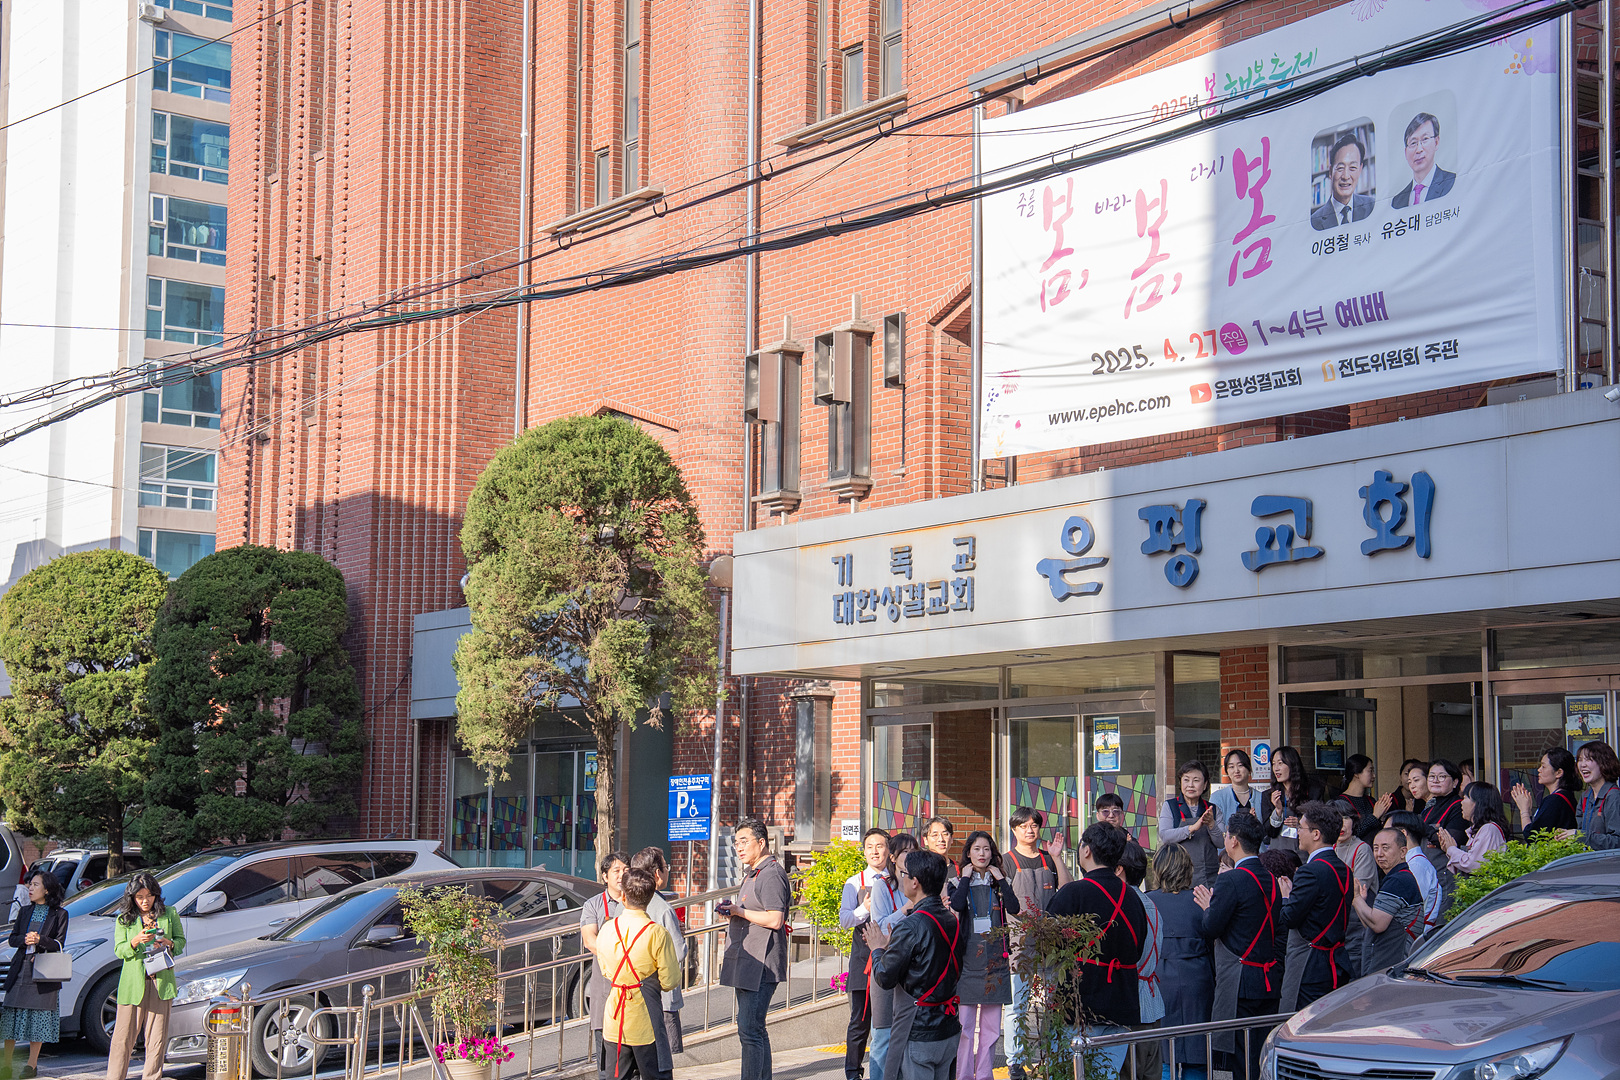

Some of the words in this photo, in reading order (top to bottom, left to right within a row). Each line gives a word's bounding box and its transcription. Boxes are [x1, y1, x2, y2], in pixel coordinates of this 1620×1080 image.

[1151, 94, 1199, 123] 2025년
[1205, 73, 1218, 118] 봄
[1223, 48, 1318, 100] 행복축제
[1017, 189, 1035, 218] 주를
[1094, 194, 1131, 214] 바라
[1190, 155, 1225, 182] 다시
[1228, 136, 1276, 286] 봄
[1381, 213, 1421, 240] 유승대
[1425, 206, 1460, 228] 담임목사
[1311, 233, 1350, 256] 이영철
[1353, 232, 1372, 246] 목사
[1091, 345, 1155, 375] 2025.
[1163, 338, 1185, 363] 4.
[1189, 329, 1218, 359] 27
[1221, 329, 1247, 349] 주일
[1252, 305, 1328, 346] 1~4부
[1335, 290, 1390, 328] 예배
[1338, 348, 1421, 379] 전도위원회
[1424, 339, 1460, 363] 주관
[1214, 367, 1302, 400] 은평성결교회
[1048, 393, 1171, 426] www.epehc.com
[1036, 469, 1436, 602] 은평교회
[832, 576, 975, 626] 대한성결교회
[676, 791, 689, 818] P
